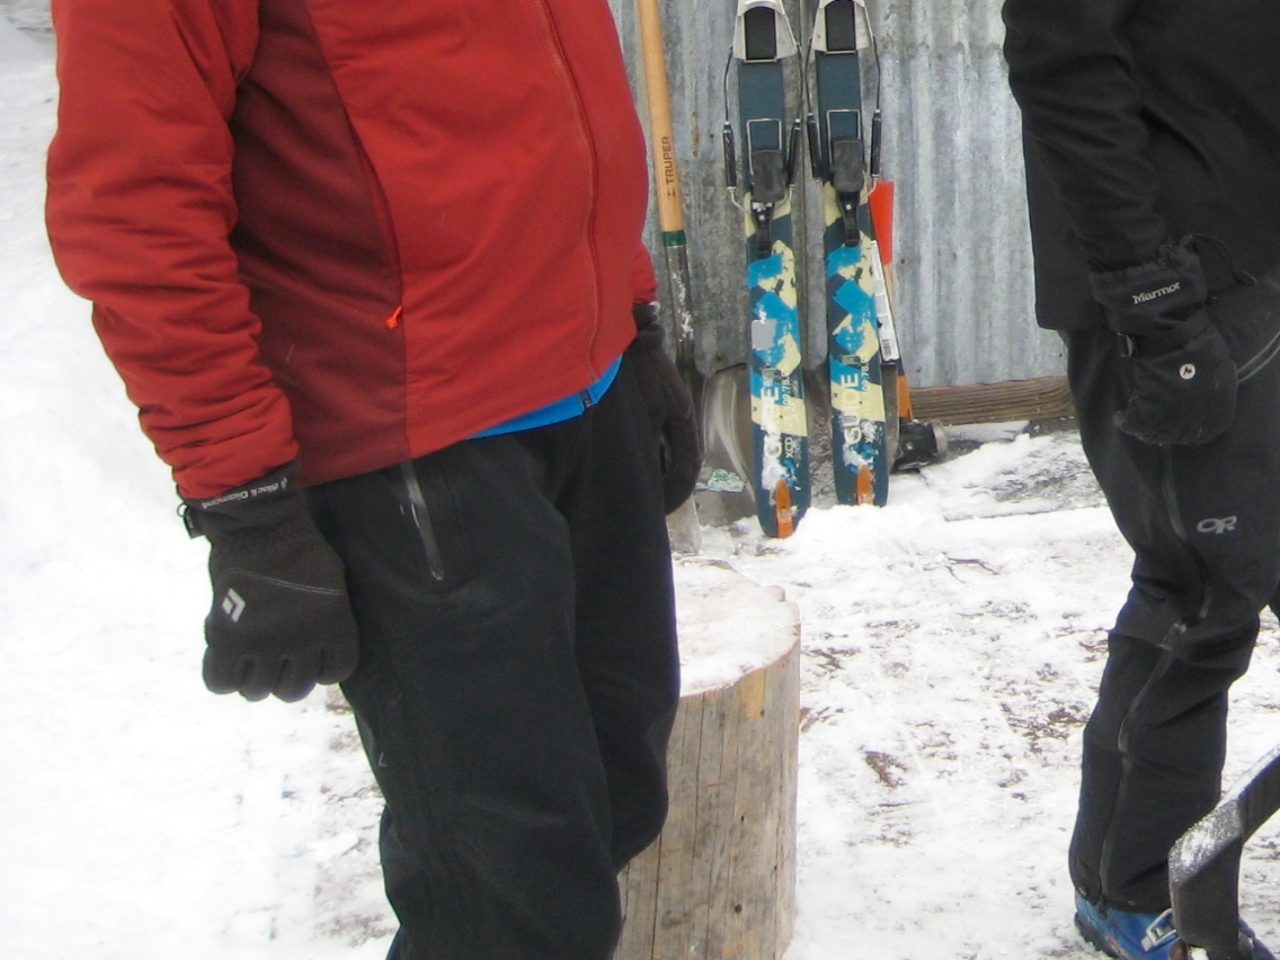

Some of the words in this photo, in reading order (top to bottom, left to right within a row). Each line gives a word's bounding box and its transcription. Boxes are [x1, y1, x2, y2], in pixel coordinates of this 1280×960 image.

[662, 136, 675, 184] TRUPER
[1132, 282, 1180, 304] Marmot
[841, 373, 862, 444] GUIDE
[1196, 515, 1238, 534] OR
